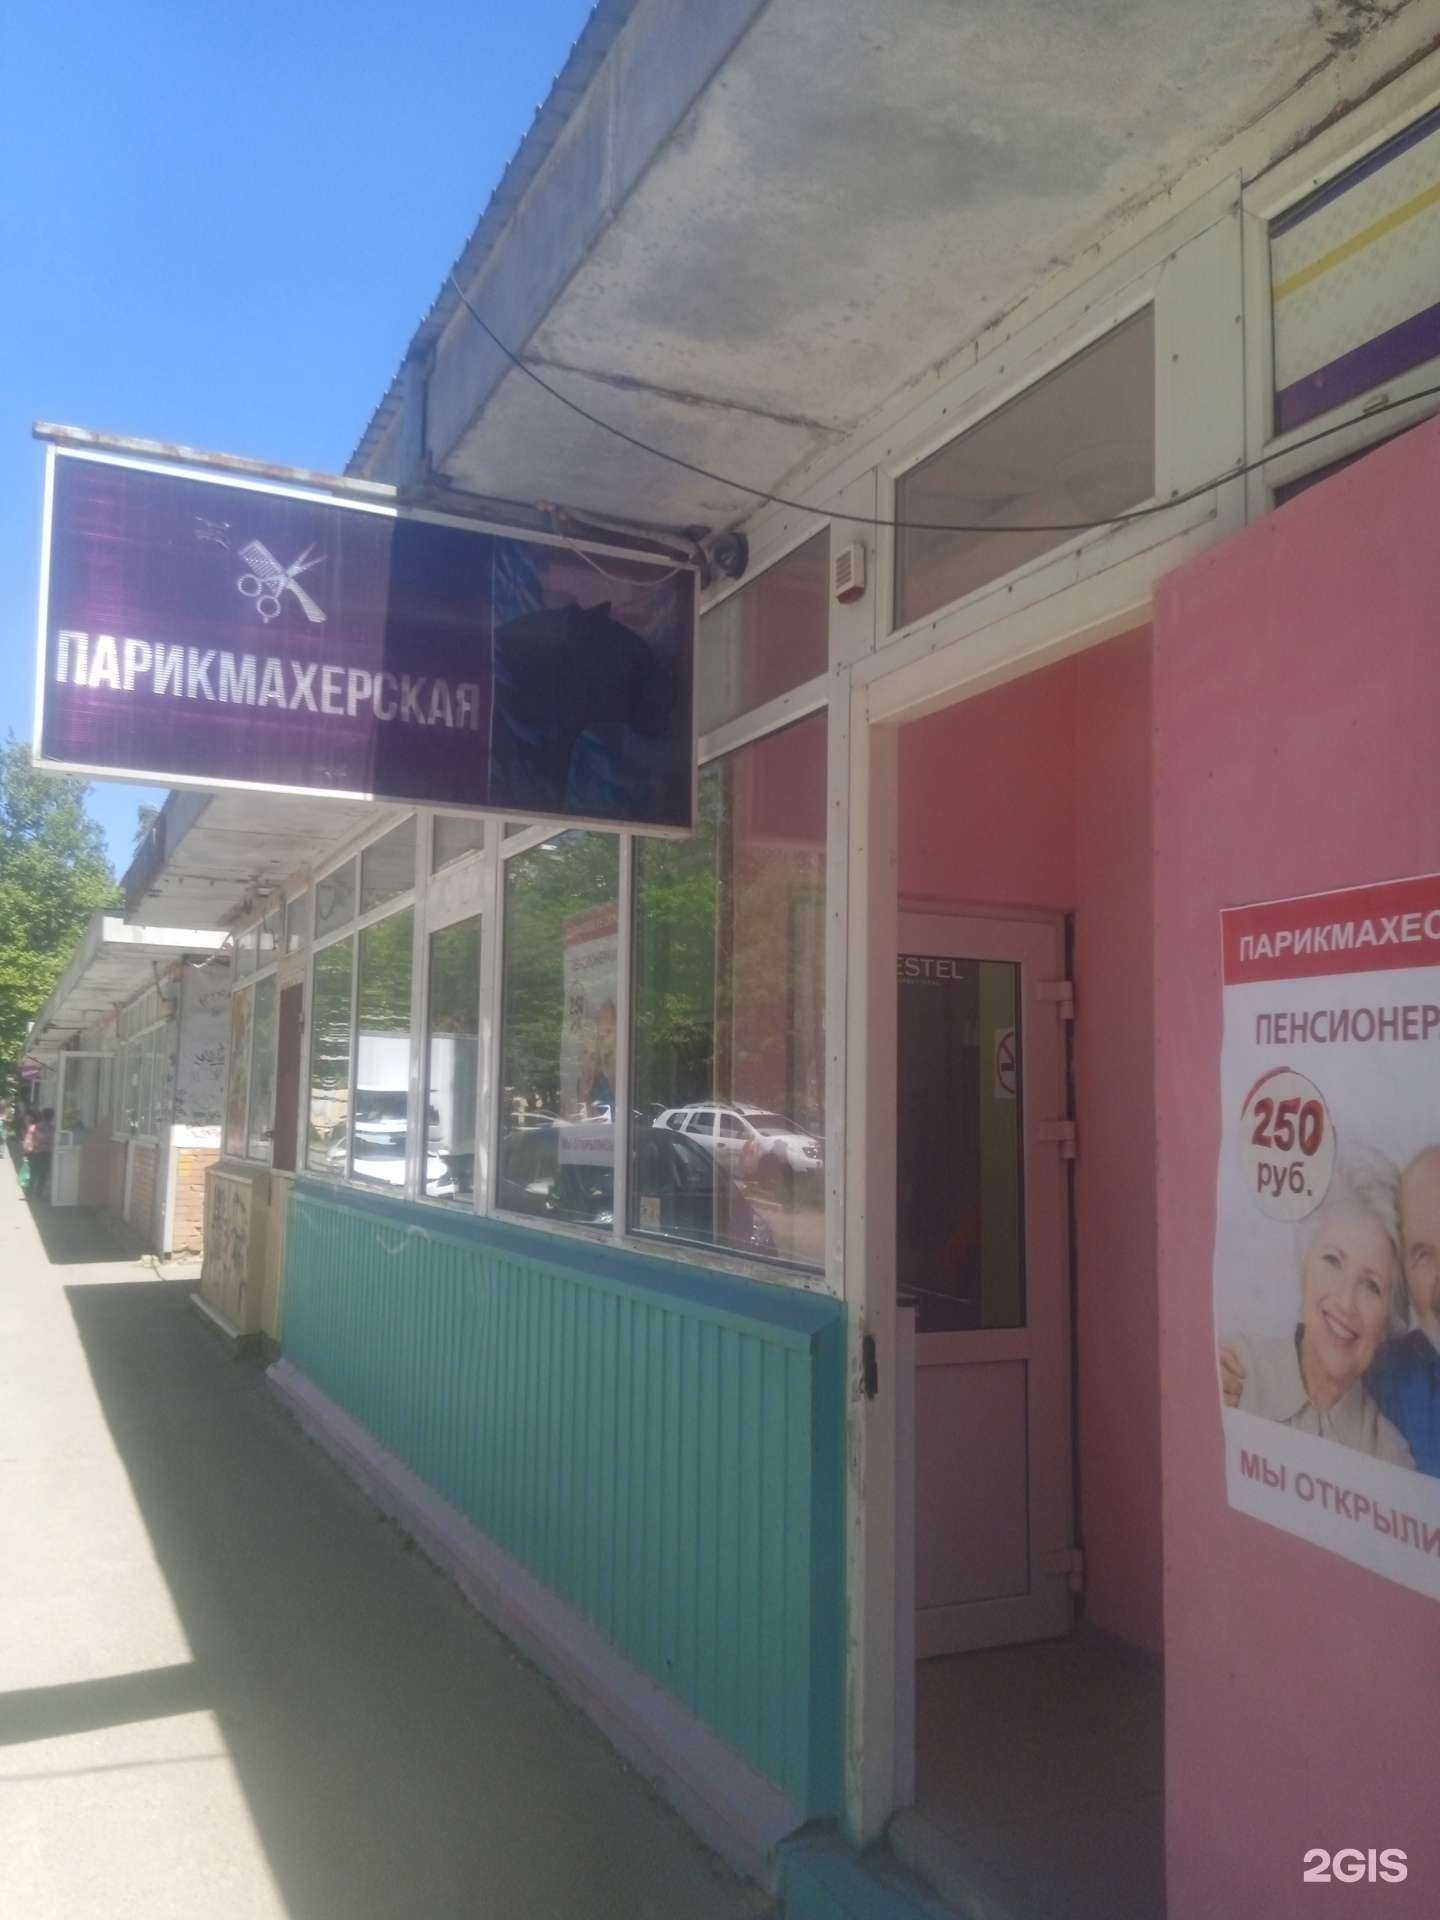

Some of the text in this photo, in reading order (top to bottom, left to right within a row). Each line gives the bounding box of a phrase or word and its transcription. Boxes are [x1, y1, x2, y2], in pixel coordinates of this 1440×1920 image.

[55, 629, 481, 731] ПАРИКМАХЕРСКАЯ
[1255, 1004, 1440, 1045] ПЕНСИОНЕР
[1251, 1097, 1324, 1156] 250
[1257, 1161, 1313, 1198] руб.
[1240, 1448, 1440, 1558] МЫ ОТКРЫЛИ
